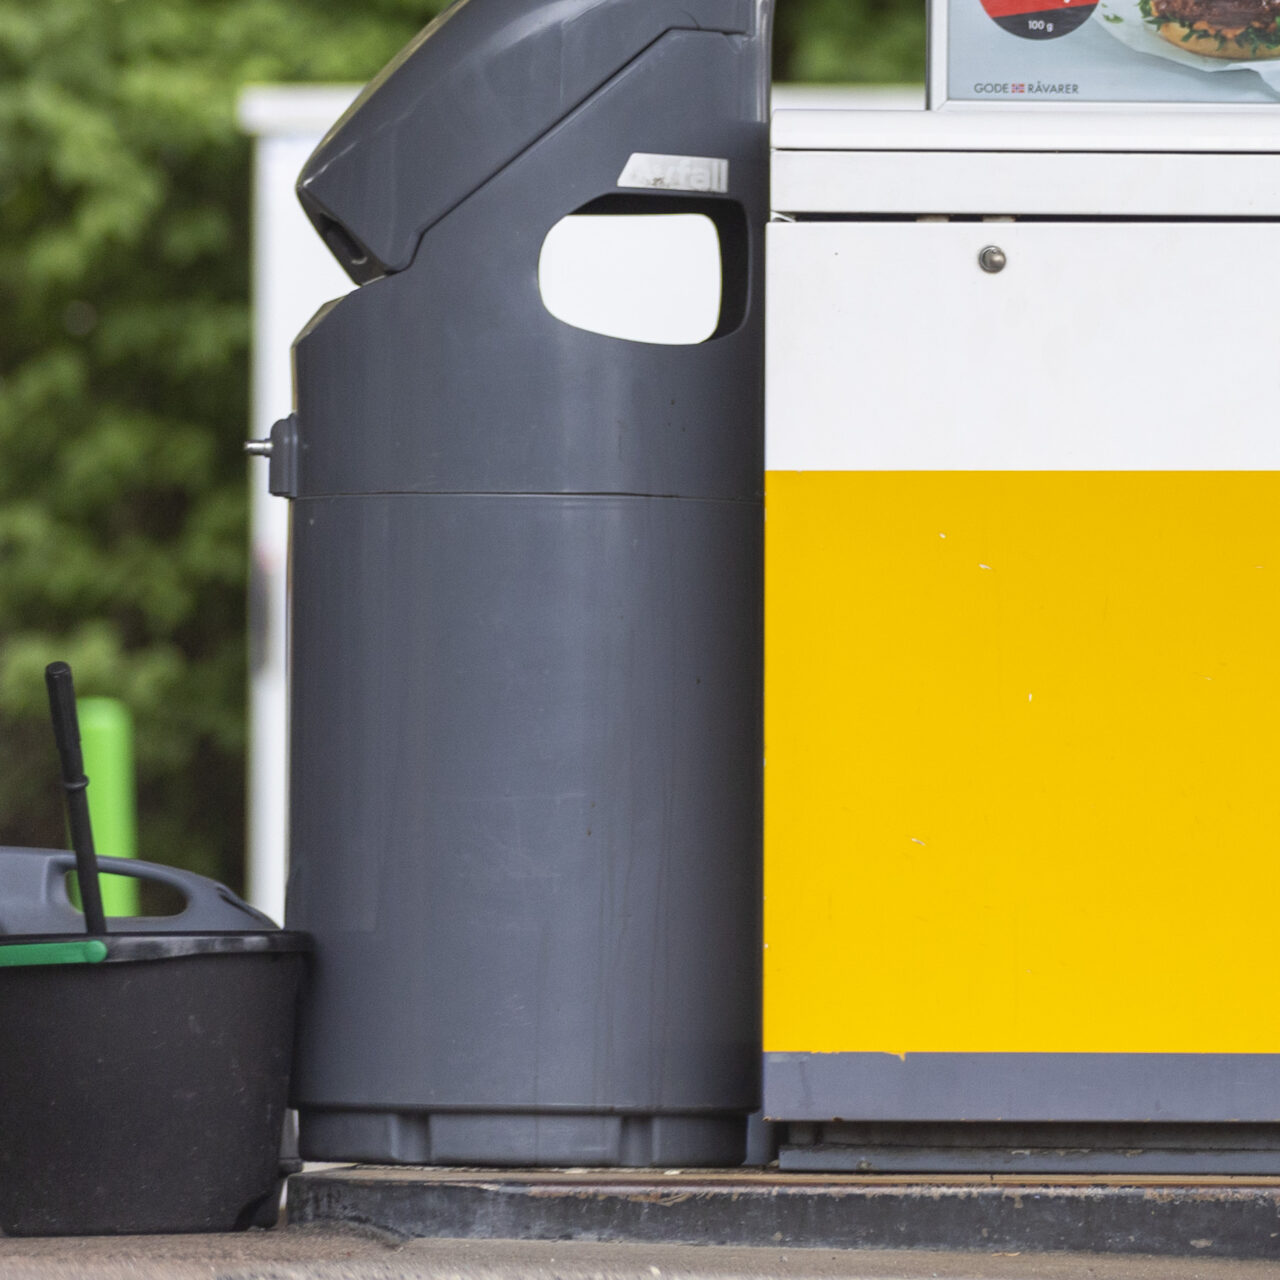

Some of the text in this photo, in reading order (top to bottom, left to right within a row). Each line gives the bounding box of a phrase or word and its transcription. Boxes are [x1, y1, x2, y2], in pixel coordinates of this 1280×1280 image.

[1028, 20, 1054, 32] 100 g
[974, 81, 1079, 94] GODE RÅVARER
